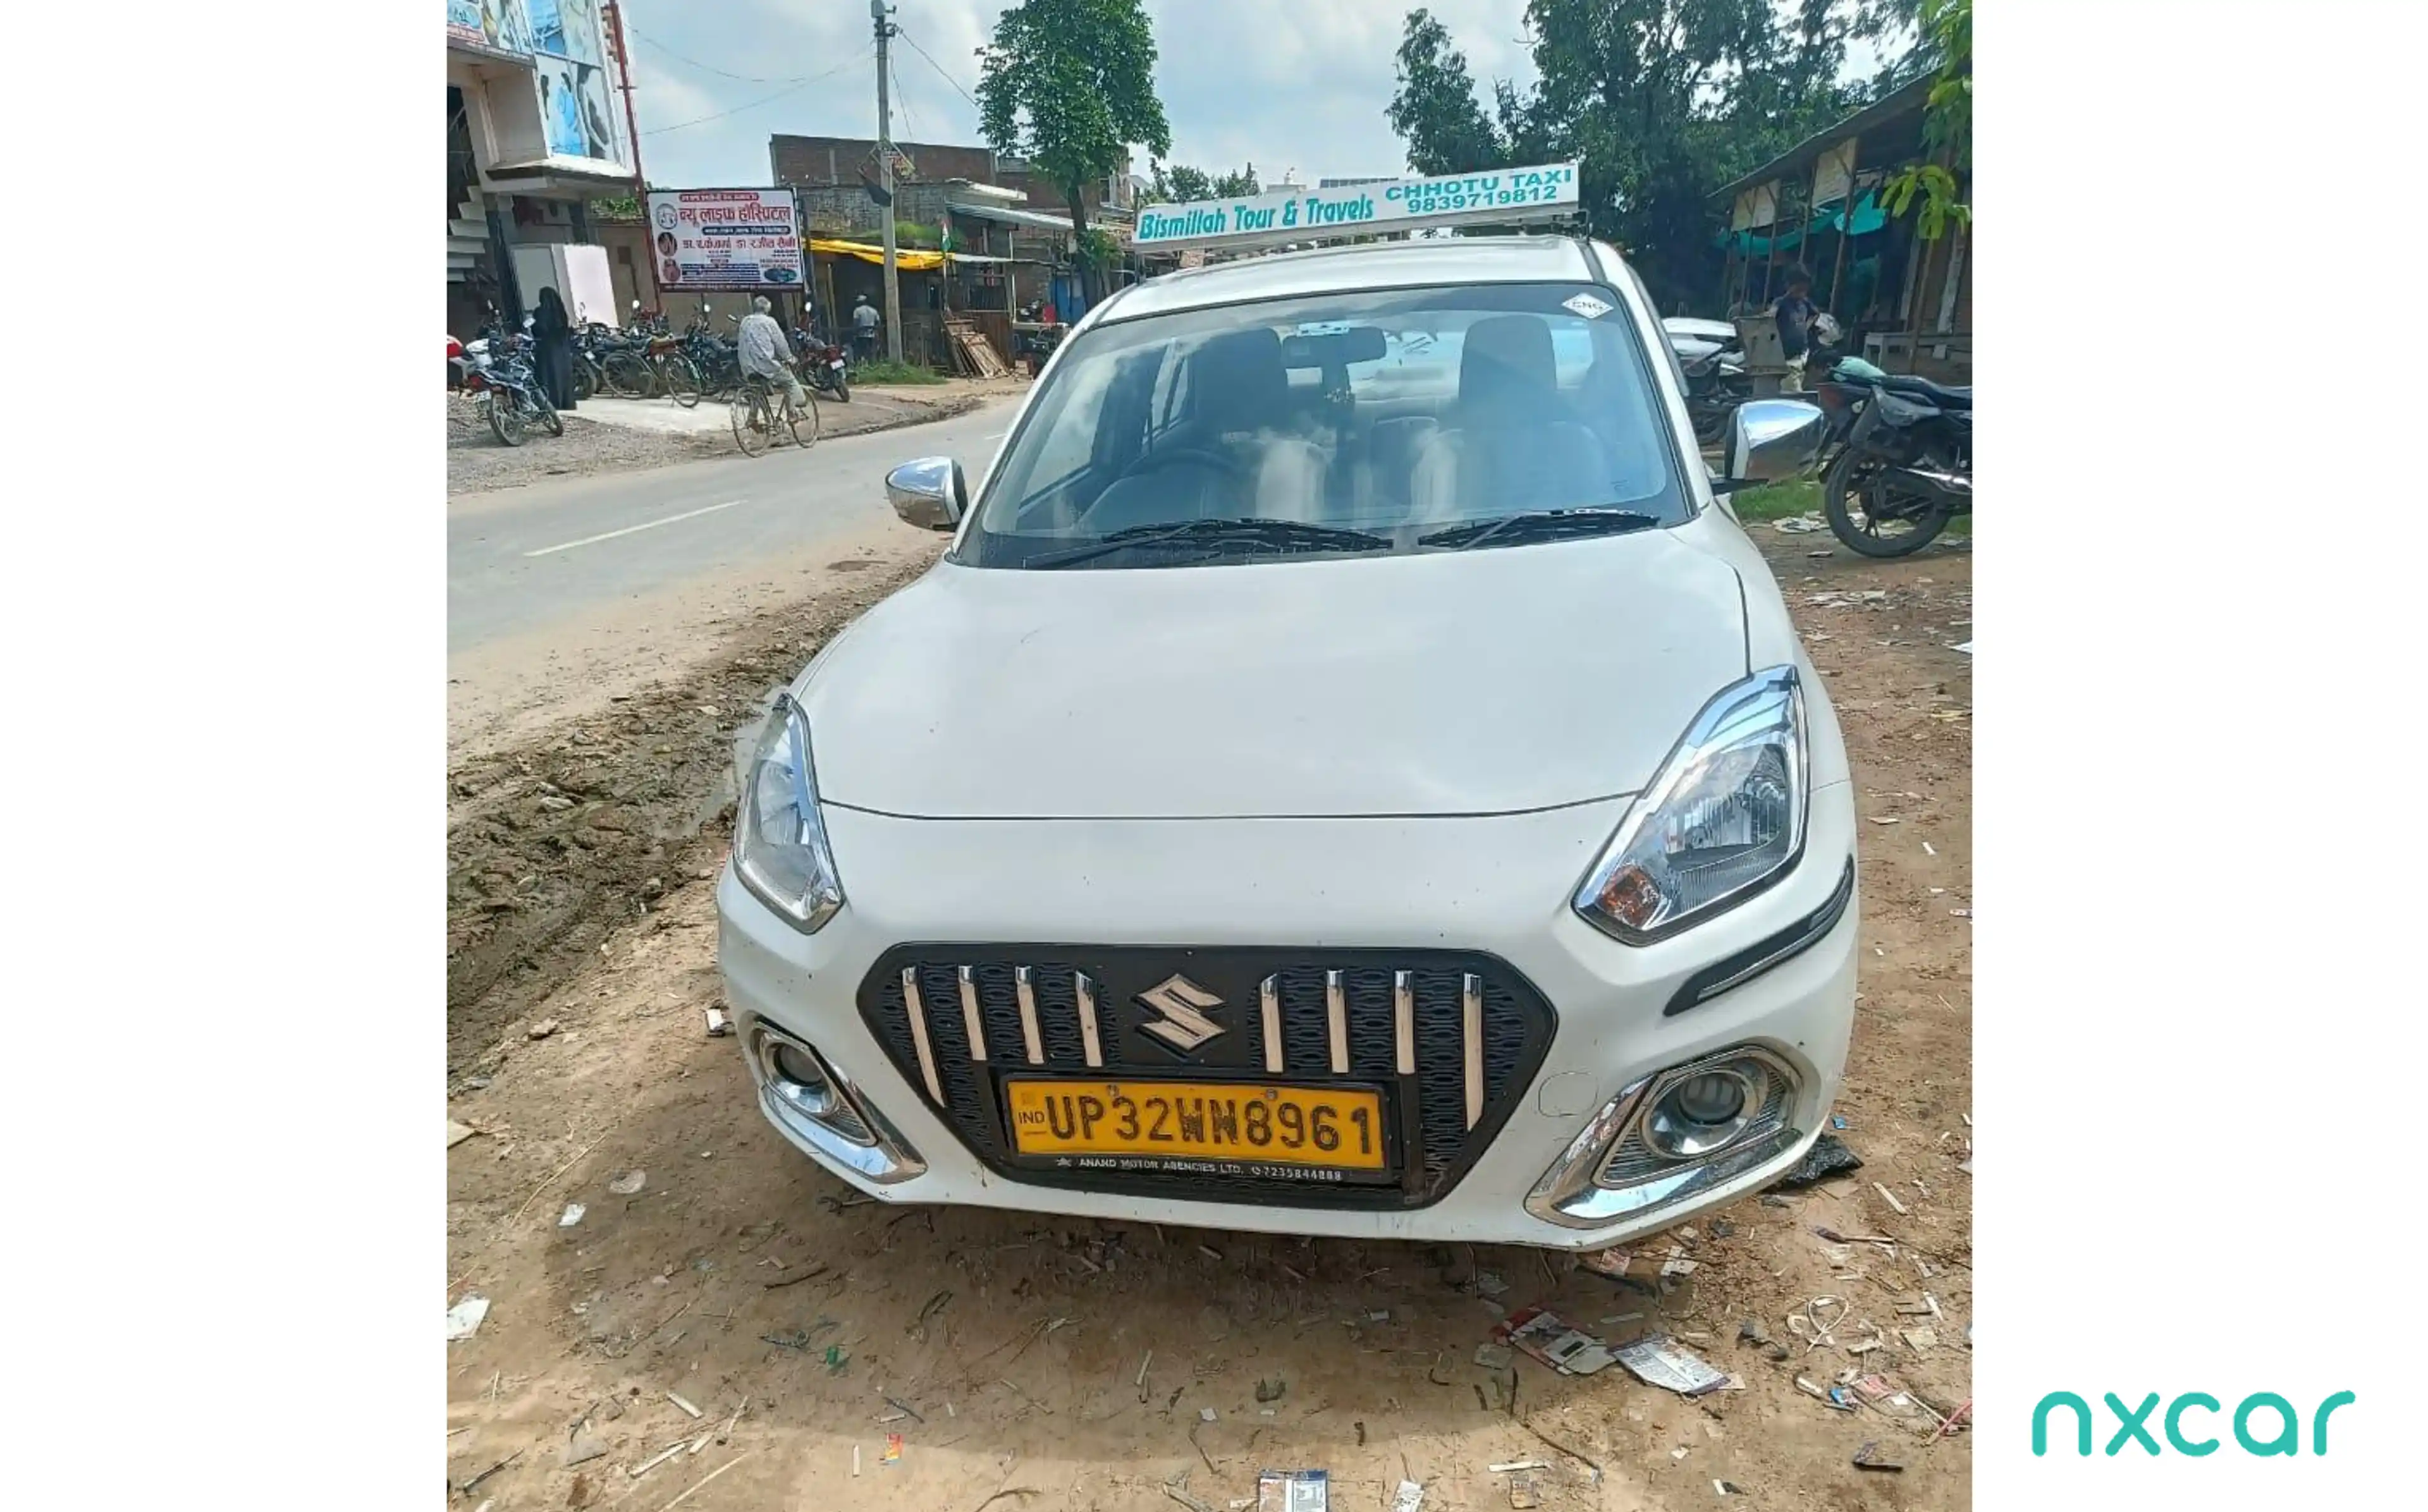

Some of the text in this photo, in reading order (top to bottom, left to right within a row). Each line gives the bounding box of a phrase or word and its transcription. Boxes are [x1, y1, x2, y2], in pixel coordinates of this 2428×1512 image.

[1385, 169, 1572, 201] CHHOTU TAXI
[1408, 186, 1557, 212] 9839719812
[1139, 193, 1373, 239] Bismillah Tour & Travels
[1019, 1111, 1045, 1124] IND
[1044, 1094, 1371, 1154] UP32WN8961
[1079, 1157, 1116, 1168] ANAND
[1120, 1159, 1158, 1169] MOTOR
[1163, 1161, 1216, 1172] AGENCIES
